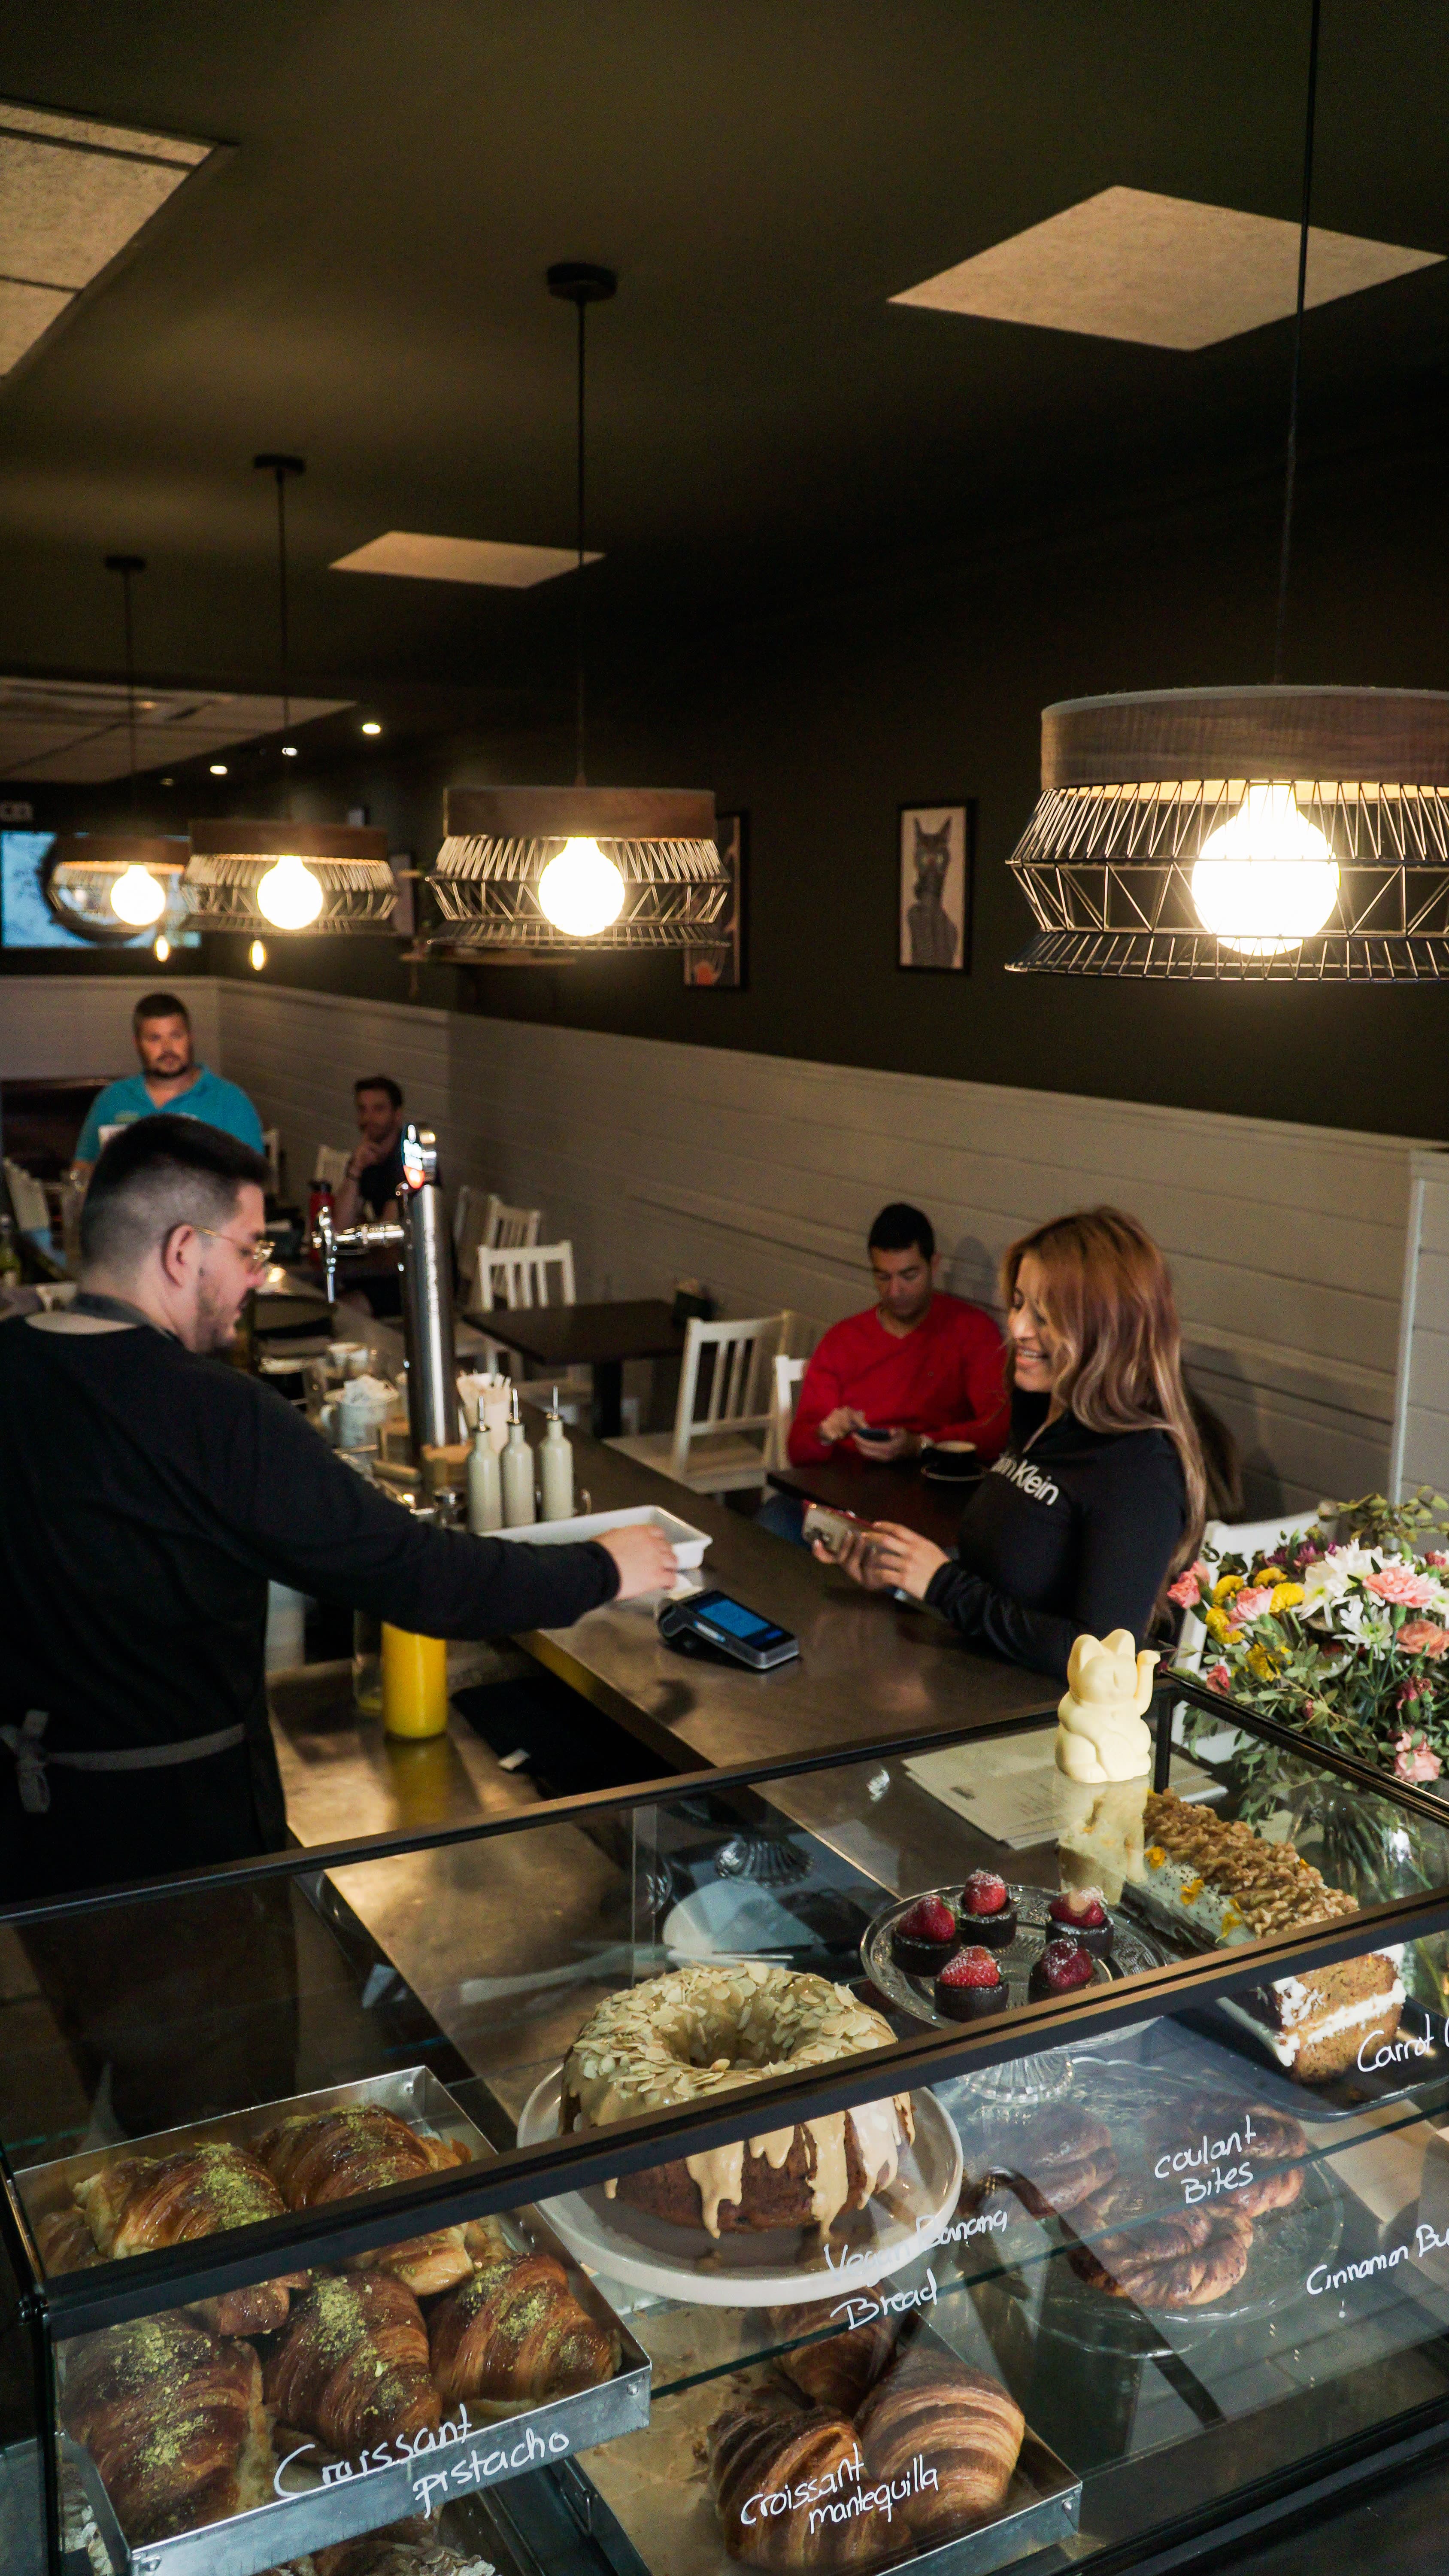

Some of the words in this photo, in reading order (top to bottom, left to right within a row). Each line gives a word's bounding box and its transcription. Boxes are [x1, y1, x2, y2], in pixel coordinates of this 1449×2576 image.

[1010, 1459, 1059, 1506] Klein
[1357, 2013, 1434, 2072] Carrot
[1180, 2161, 1253, 2204] Bites
[824, 2242, 910, 2287] Vegan
[916, 2210, 1007, 2253] Banana
[1306, 2245, 1408, 2295] Cinnamon
[830, 2268, 937, 2330] Bread
[273, 2403, 472, 2497] Croissant
[809, 2454, 939, 2534] mantequilla
